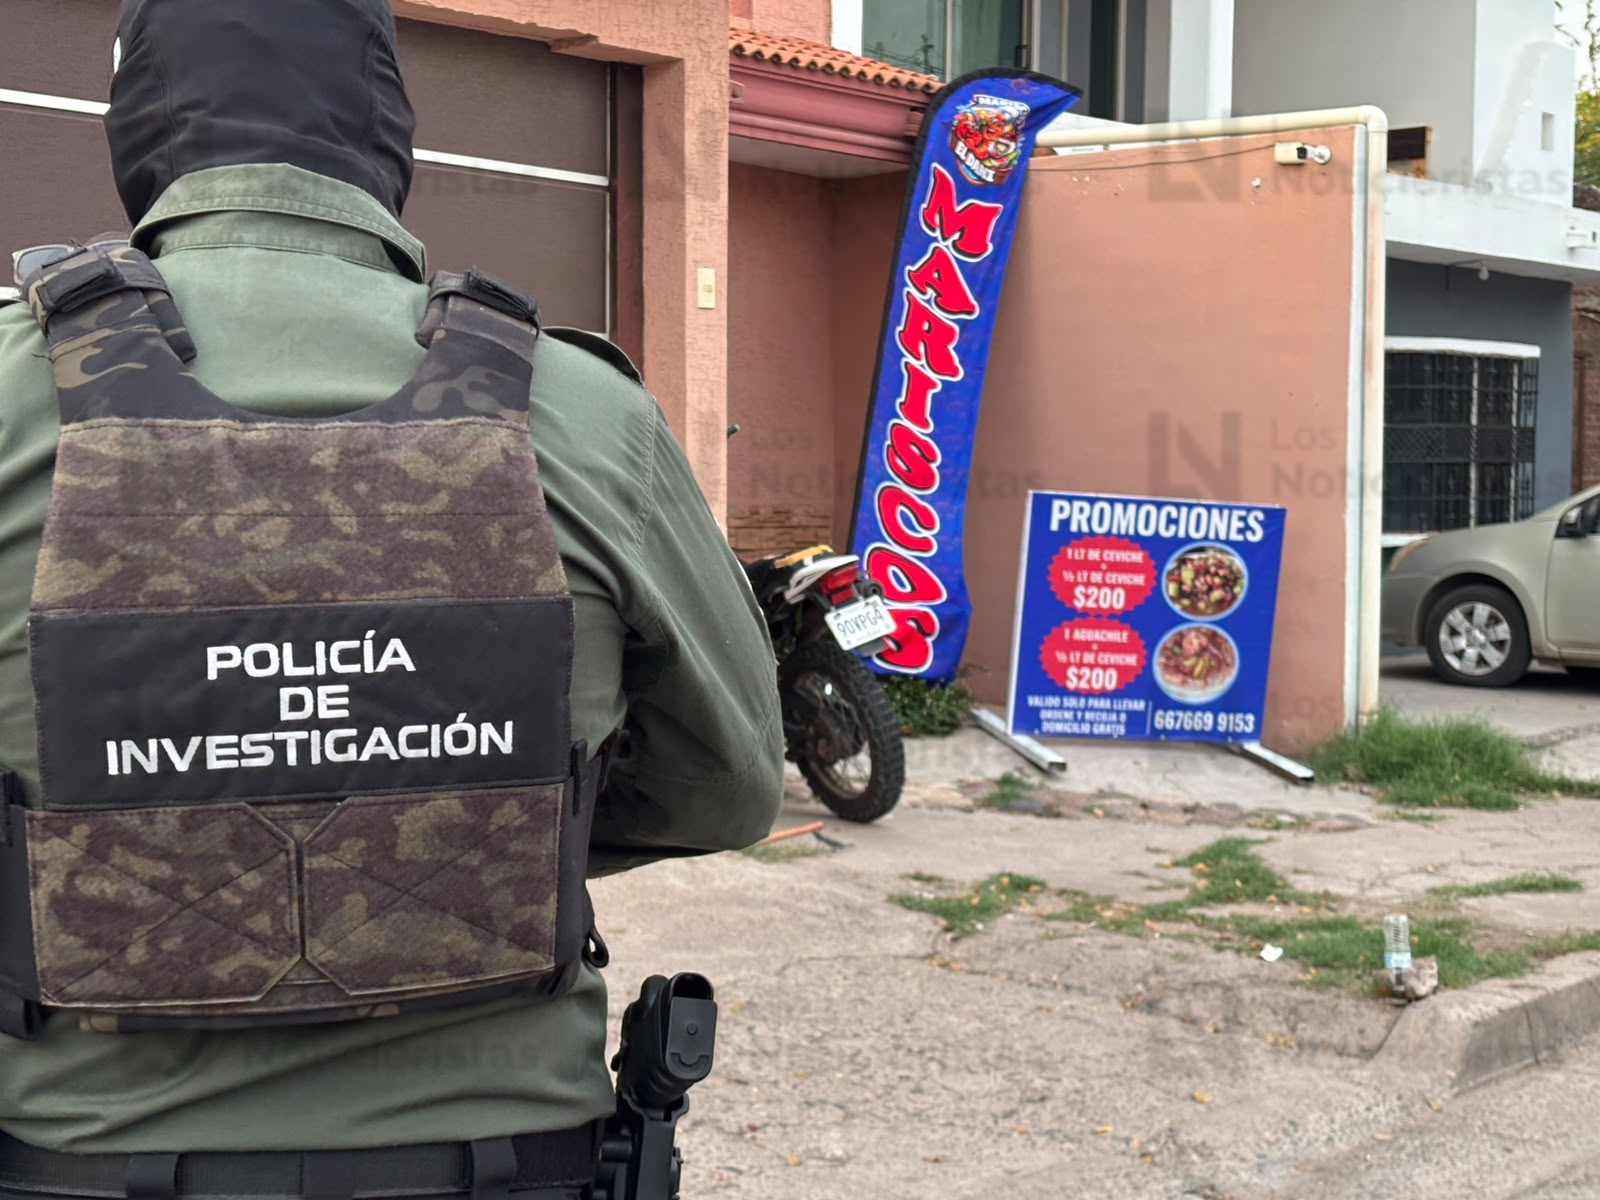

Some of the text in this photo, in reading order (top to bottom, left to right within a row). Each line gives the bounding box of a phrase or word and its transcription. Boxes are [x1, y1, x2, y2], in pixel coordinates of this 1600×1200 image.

[864, 163, 1003, 674] MARISCOS
[1049, 499, 1265, 543] PROMOCIONES
[1074, 549, 1086, 561] LT
[1087, 550, 1101, 561] DE
[1103, 551, 1144, 563] CEVICHE
[1077, 572, 1089, 583] LT
[1090, 572, 1103, 584] DE
[1105, 573, 1146, 586] CEVICHE
[1073, 585, 1126, 610] $200
[1072, 629, 1129, 643] AGUACHILE
[206, 630, 416, 680] POLICÍA
[1070, 652, 1081, 664] LT
[1083, 652, 1096, 665] DE
[1098, 653, 1138, 666] CEVICHE
[1065, 665, 1118, 691] $200
[279, 684, 350, 721] DE
[1027, 695, 1146, 711] VALIDO SOLO PARA LLEVAR
[1039, 709, 1074, 720] ORDENE
[1076, 710, 1083, 720] Y
[1153, 710, 1255, 733] 667669 9153
[1041, 721, 1126, 736] DOMICILIO GRATIS
[106, 712, 514, 776] INVESTIGACIÓN
